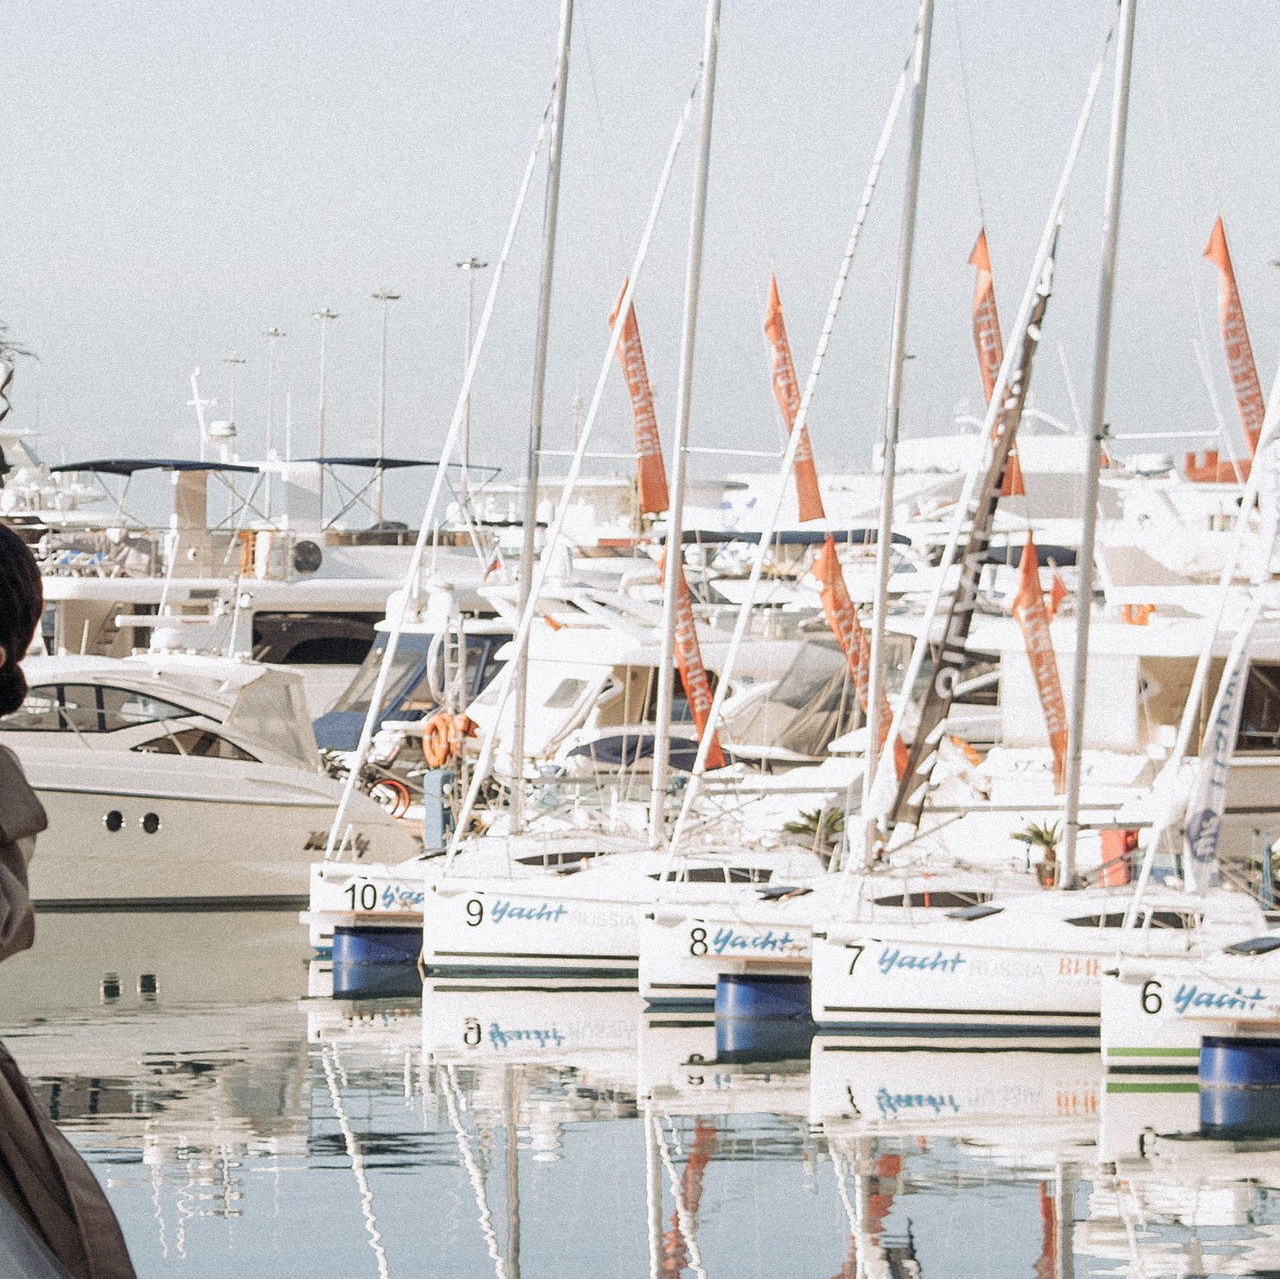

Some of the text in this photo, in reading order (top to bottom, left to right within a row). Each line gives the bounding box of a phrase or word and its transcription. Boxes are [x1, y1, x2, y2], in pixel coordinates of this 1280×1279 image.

[345, 883, 378, 911] 10
[466, 898, 484, 927] 9
[490, 898, 568, 923] Yacht
[689, 926, 794, 957] 8 Yacht
[844, 943, 865, 976] 7
[877, 945, 966, 975] Yacht
[1141, 979, 1163, 1015] 6
